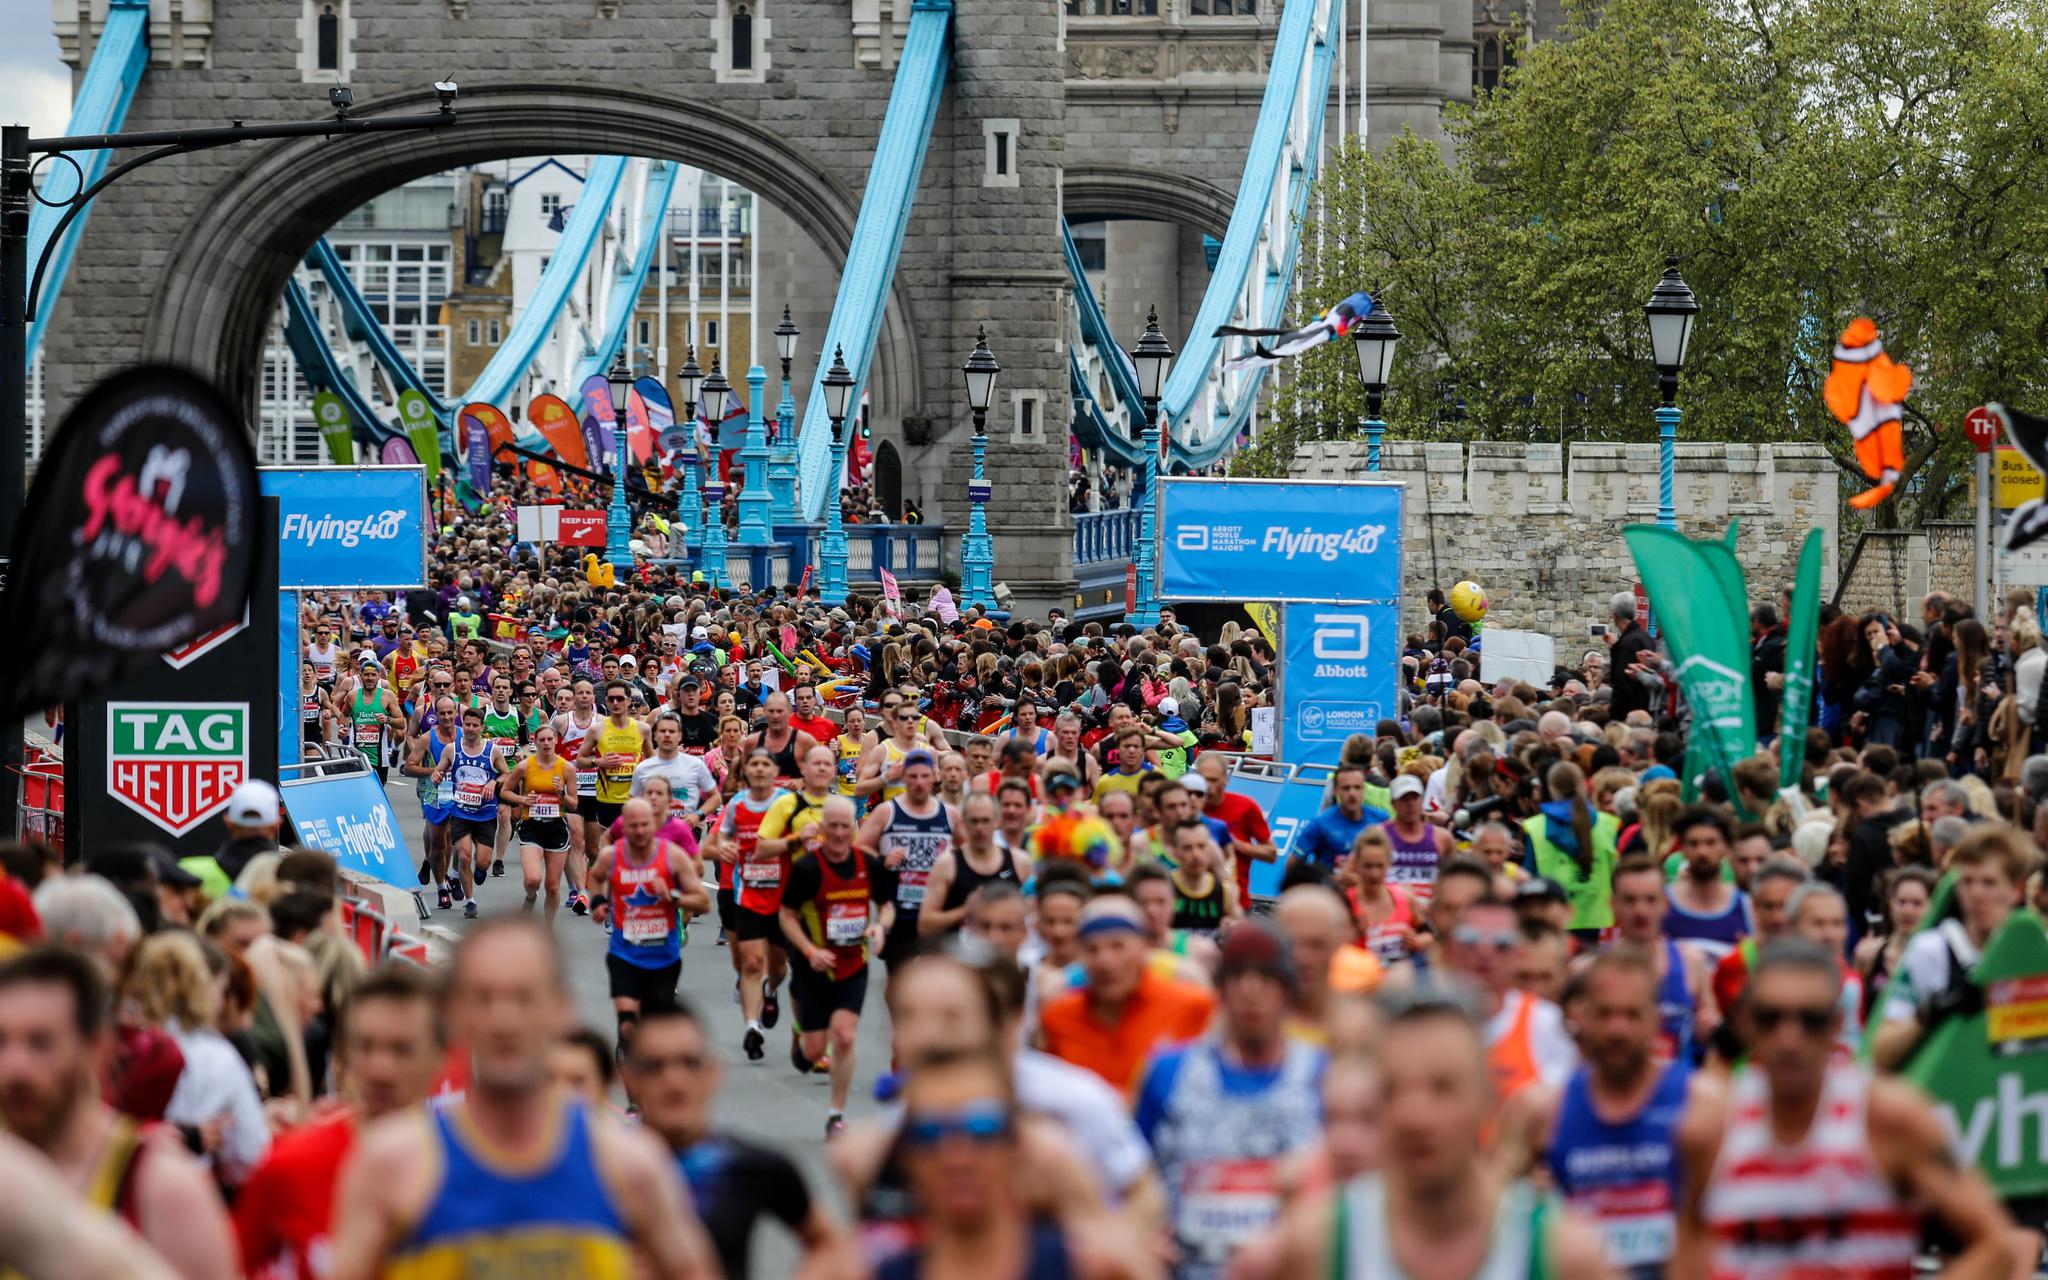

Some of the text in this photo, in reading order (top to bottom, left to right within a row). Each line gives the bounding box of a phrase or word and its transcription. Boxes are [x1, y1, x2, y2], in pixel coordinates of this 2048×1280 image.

[2002, 460, 2023, 471] Bus
[2000, 475, 2040, 485] closed
[561, 517, 604, 525] KEEP LEFT!
[1313, 664, 1369, 678] Abbott
[1326, 719, 1375, 727] MARATHON
[120, 713, 234, 751] TAG
[459, 759, 486, 768] ALEX
[117, 764, 239, 824] HEUER
[535, 806, 552, 816] 401
[891, 836, 940, 847] TICKETS
[909, 848, 933, 858] FOR
[620, 869, 658, 884] MARK
